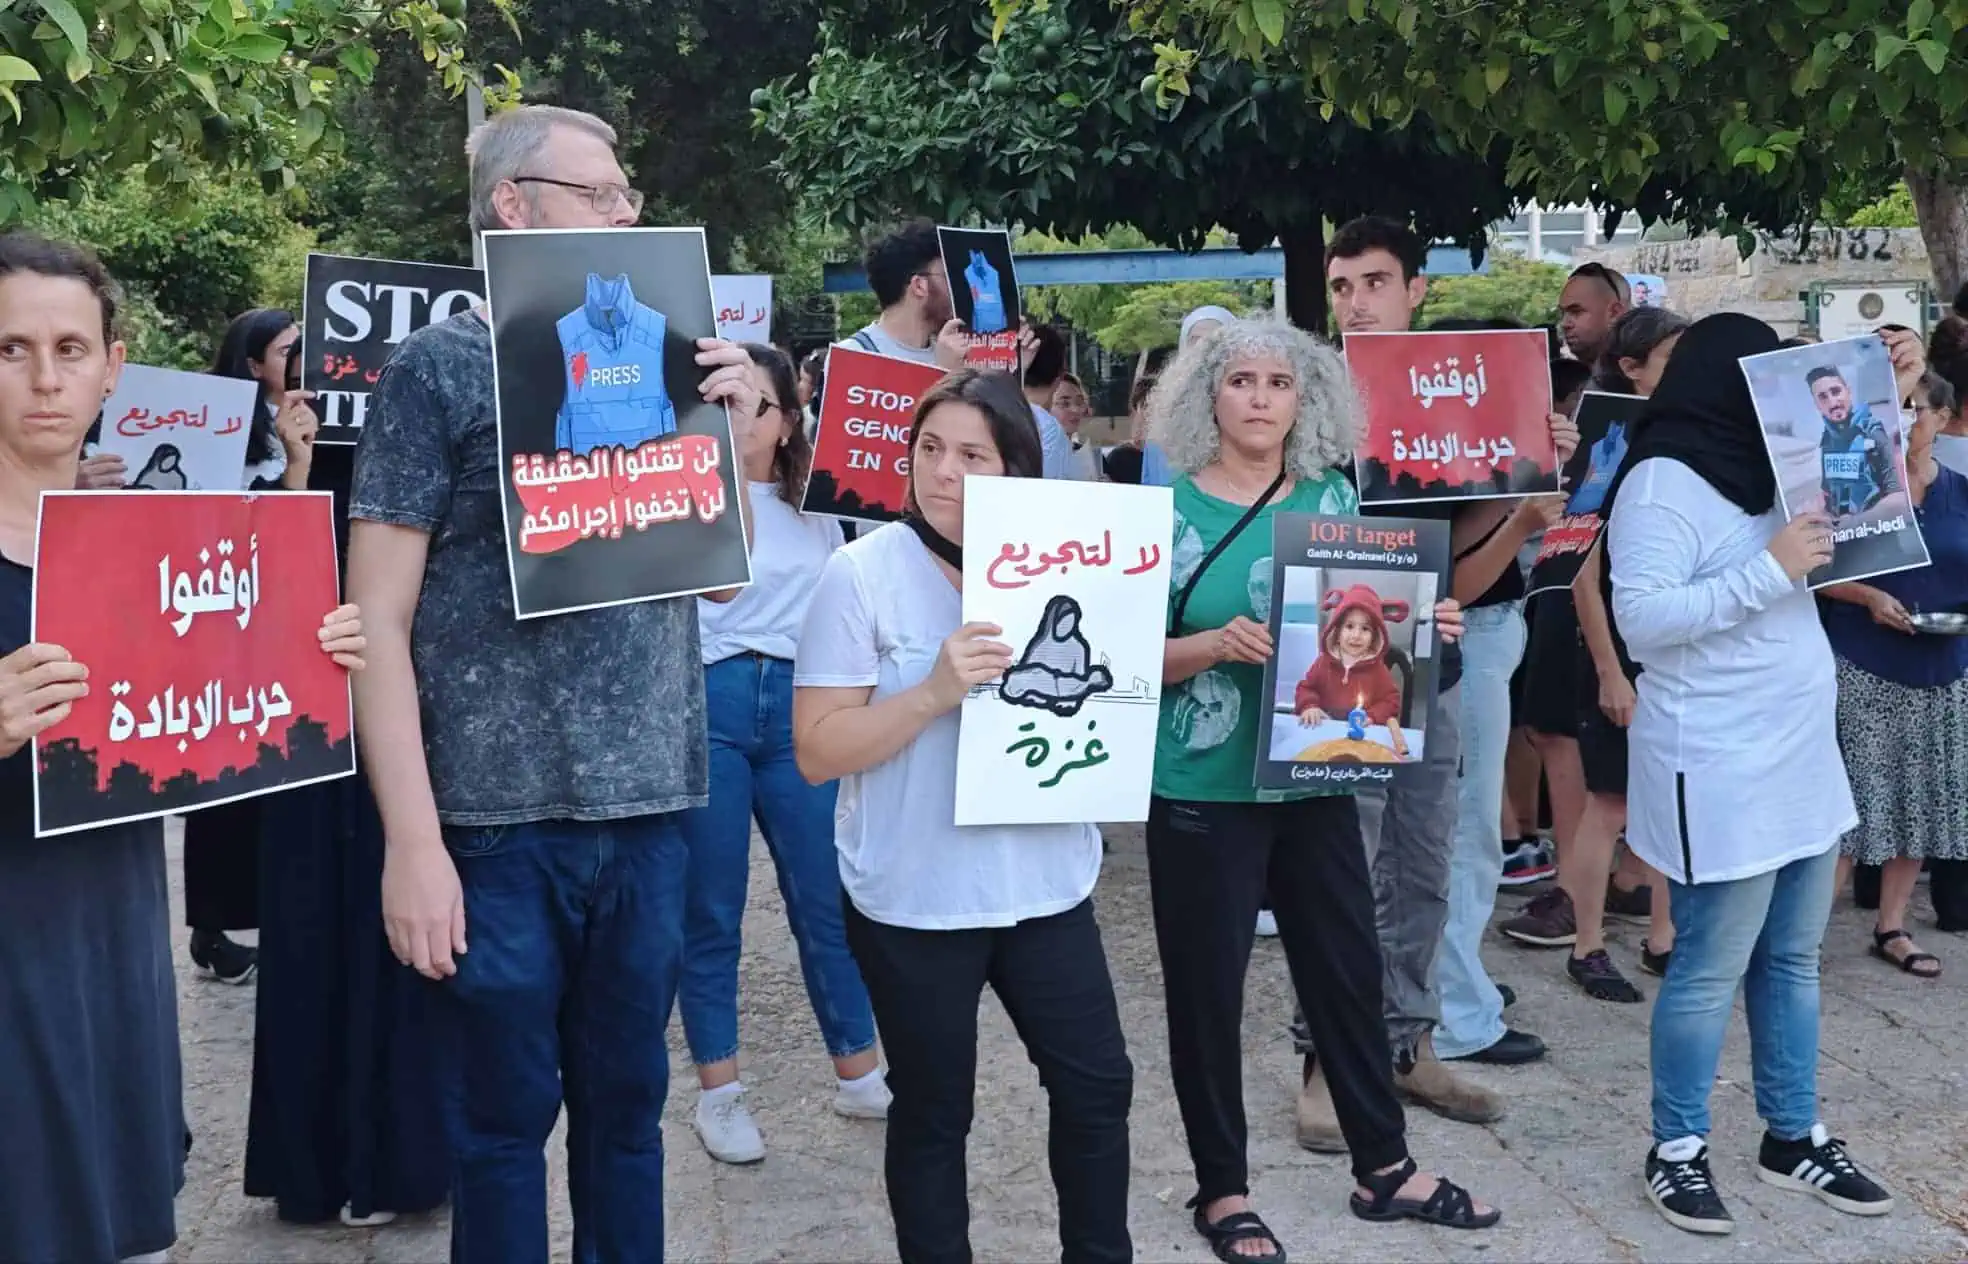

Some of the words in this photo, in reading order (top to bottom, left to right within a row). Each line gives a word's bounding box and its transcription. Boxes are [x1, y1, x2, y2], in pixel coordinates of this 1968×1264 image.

[717, 300, 745, 327] لتج
[322, 353, 359, 380] غزة
[591, 364, 641, 387] PRESS
[1408, 353, 1488, 409] أوقفوا
[847, 385, 915, 412] STOP
[116, 404, 209, 437] لتجويع
[213, 416, 242, 435] لا
[616, 444, 684, 482] تقتلوا
[693, 441, 720, 474] لن
[846, 449, 882, 471] IN
[1391, 428, 1459, 470] الابادة
[1463, 436, 1516, 467] حرب
[1825, 457, 1858, 473] PRESS
[515, 450, 610, 493] الحقيقة
[624, 488, 691, 530] تخفوا
[698, 487, 725, 520] لن
[521, 499, 622, 547] إجرامكم
[1309, 521, 1352, 544] IOF
[1355, 526, 1417, 552] target
[1855, 515, 1906, 539] al-Jedi
[986, 530, 1112, 589] لتجويع
[1122, 543, 1160, 575] لا
[158, 532, 260, 638] أوقفوا
[108, 678, 223, 754] الابادة
[228, 681, 292, 743] حرب
[1005, 719, 1110, 788] غزة
